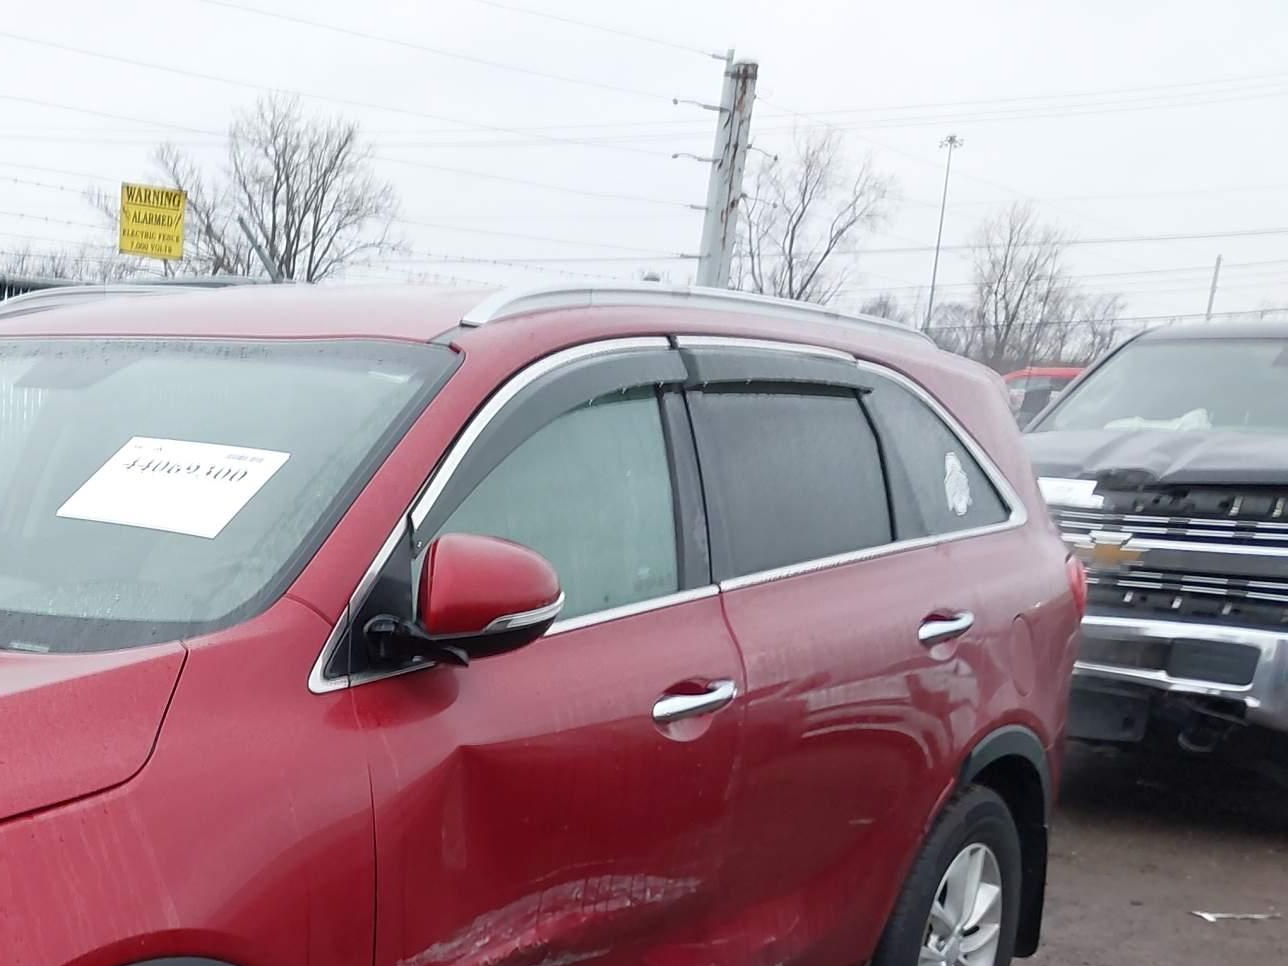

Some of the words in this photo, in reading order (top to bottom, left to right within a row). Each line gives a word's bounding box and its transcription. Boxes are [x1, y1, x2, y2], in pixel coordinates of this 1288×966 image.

[126, 185, 181, 208] WARNING
[131, 210, 173, 227] ALARMED
[122, 229, 156, 240] ELECTRIC
[123, 458, 249, 482] 44069300
